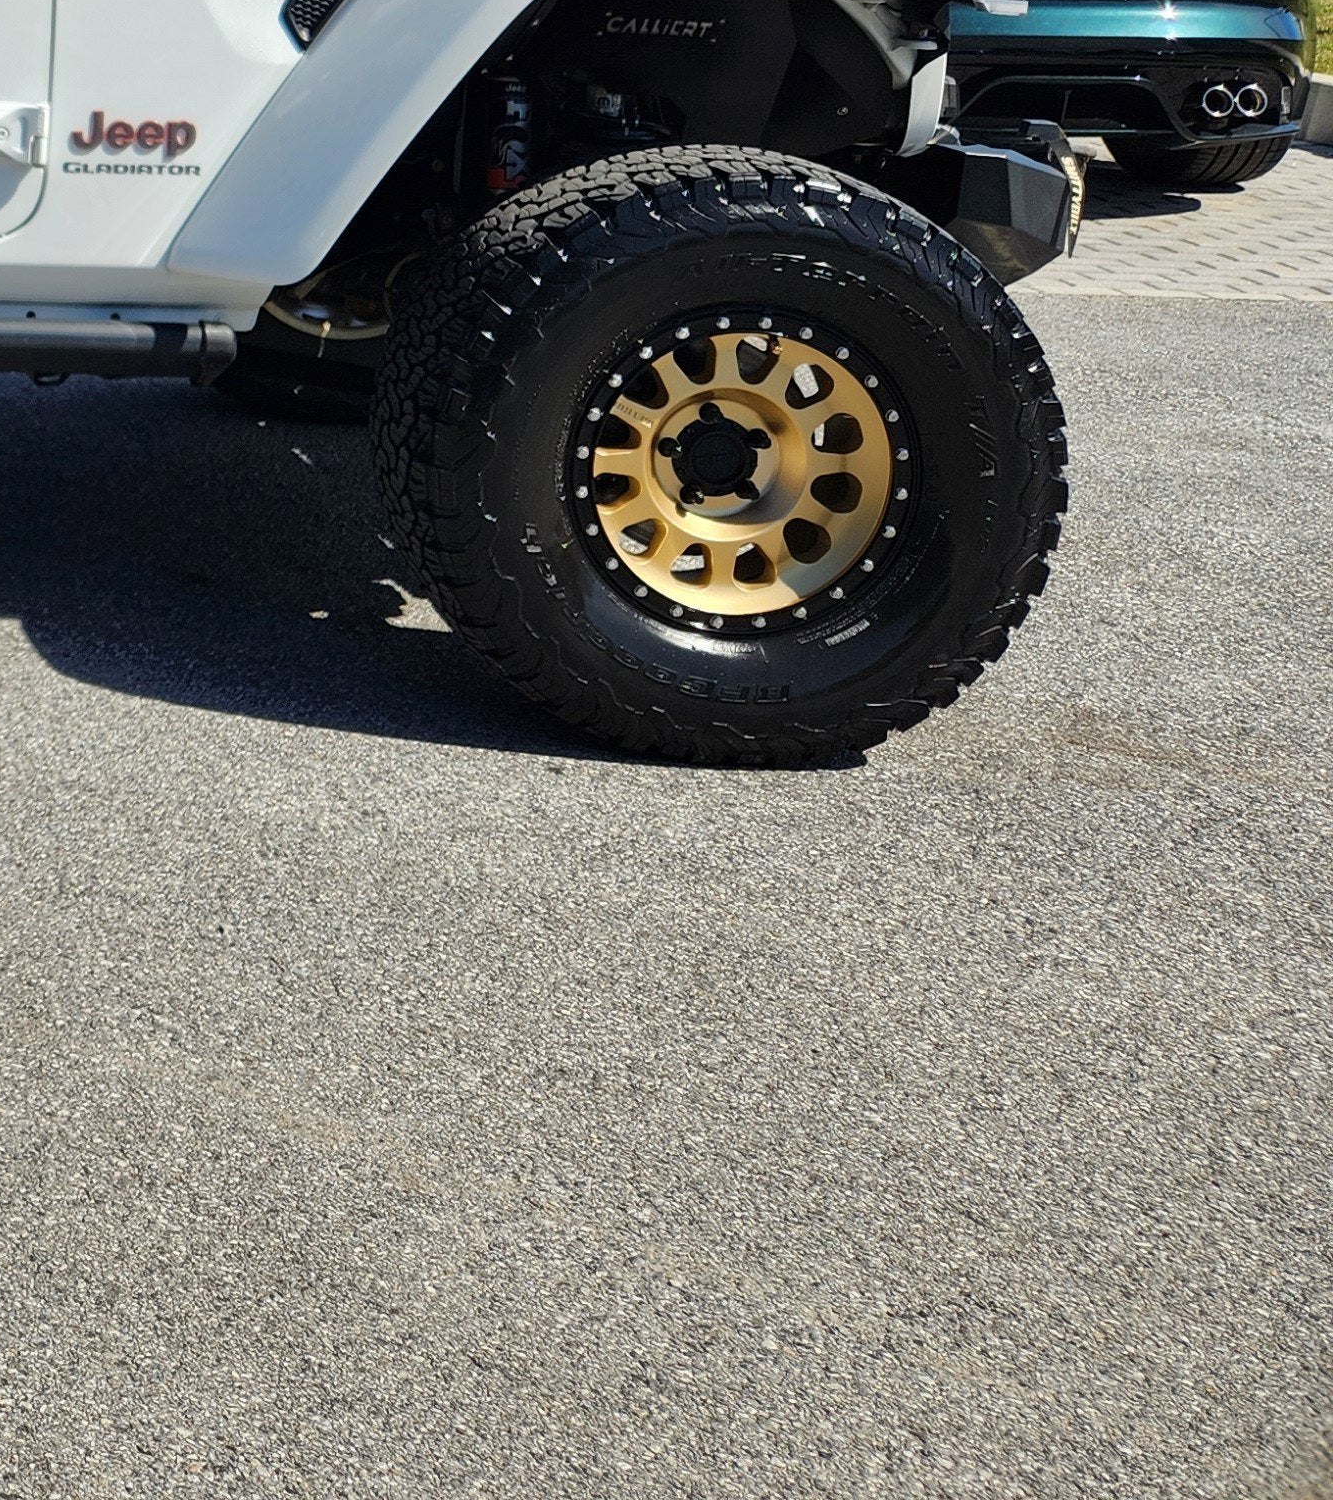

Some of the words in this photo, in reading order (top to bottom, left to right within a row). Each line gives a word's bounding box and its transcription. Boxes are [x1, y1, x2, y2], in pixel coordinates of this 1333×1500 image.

[71, 110, 197, 158] Jeep
[62, 161, 201, 177] GLADIATOR
[1060, 156, 1083, 236] SMITTYBILT
